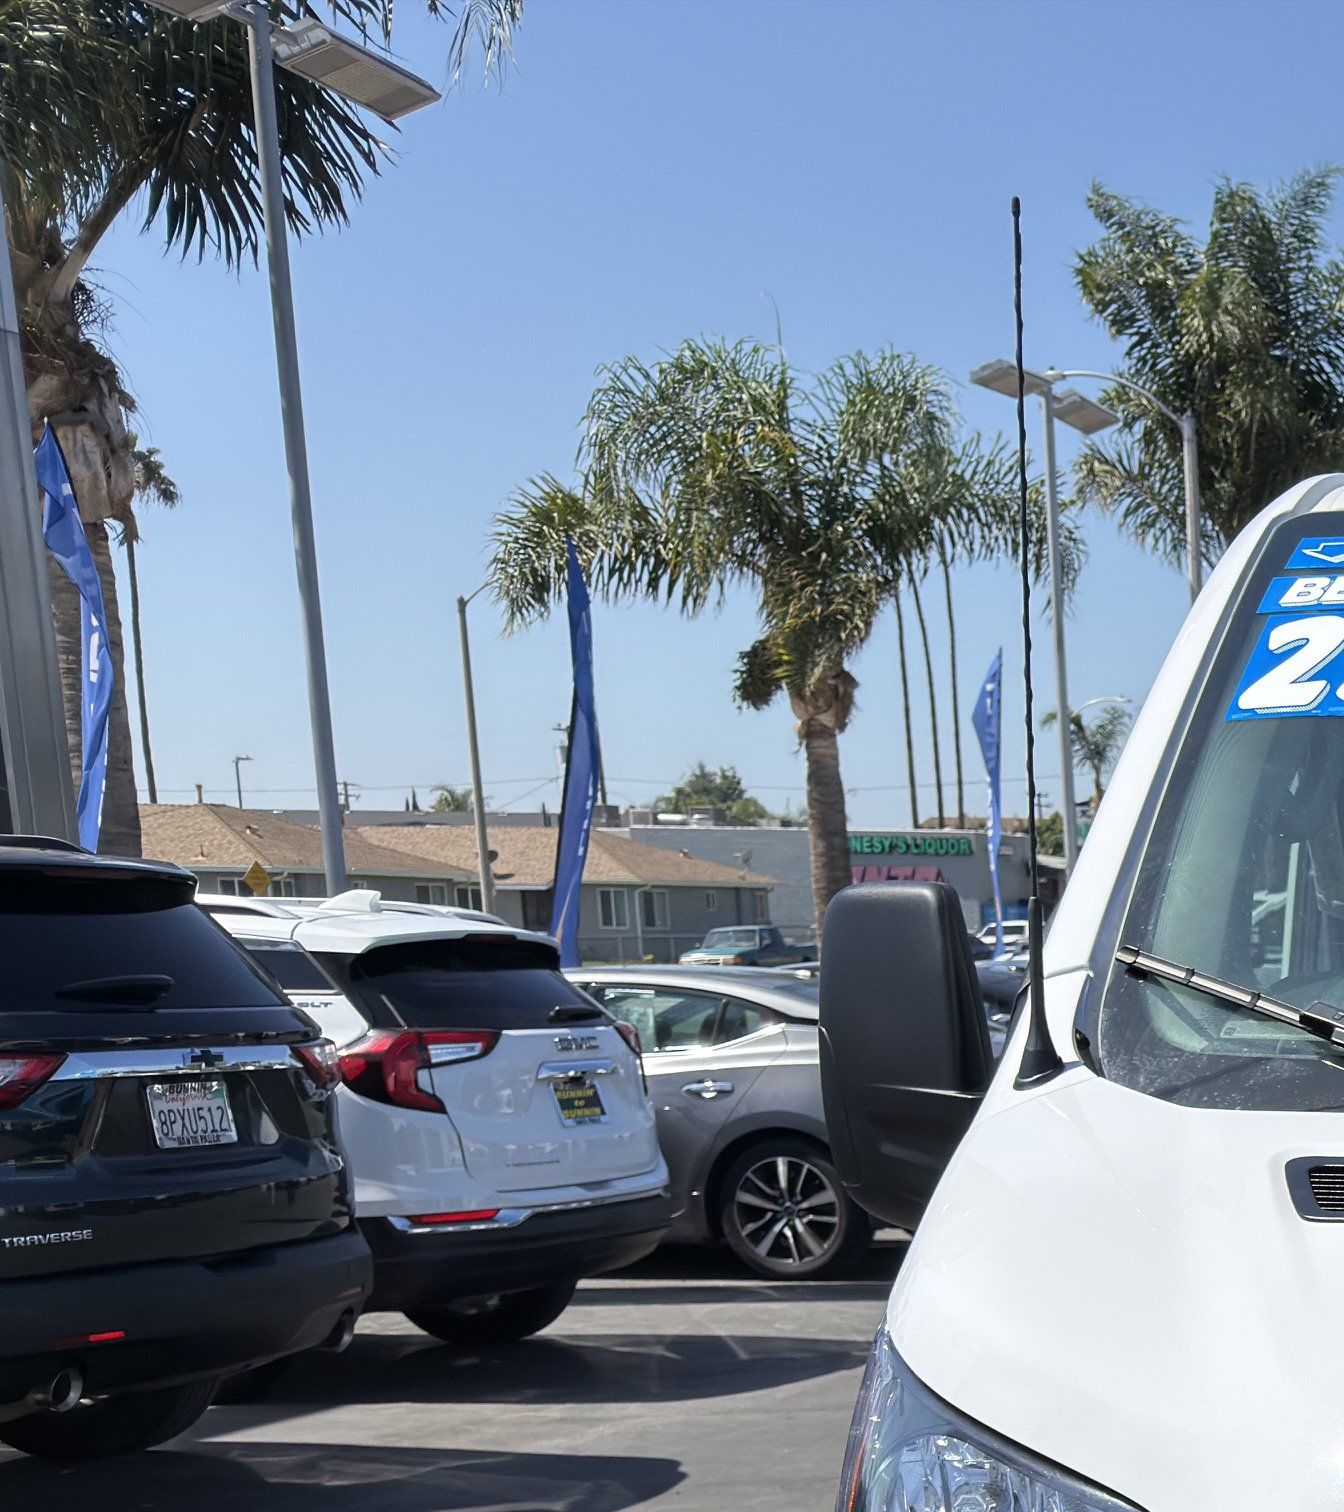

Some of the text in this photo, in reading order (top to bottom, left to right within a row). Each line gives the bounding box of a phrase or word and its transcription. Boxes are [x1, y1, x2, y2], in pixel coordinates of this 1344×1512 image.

[911, 837, 971, 856] LIQUOR
[158, 1106, 229, 1136] 8PXU512
[2, 1229, 93, 1249] TRAVERSE
